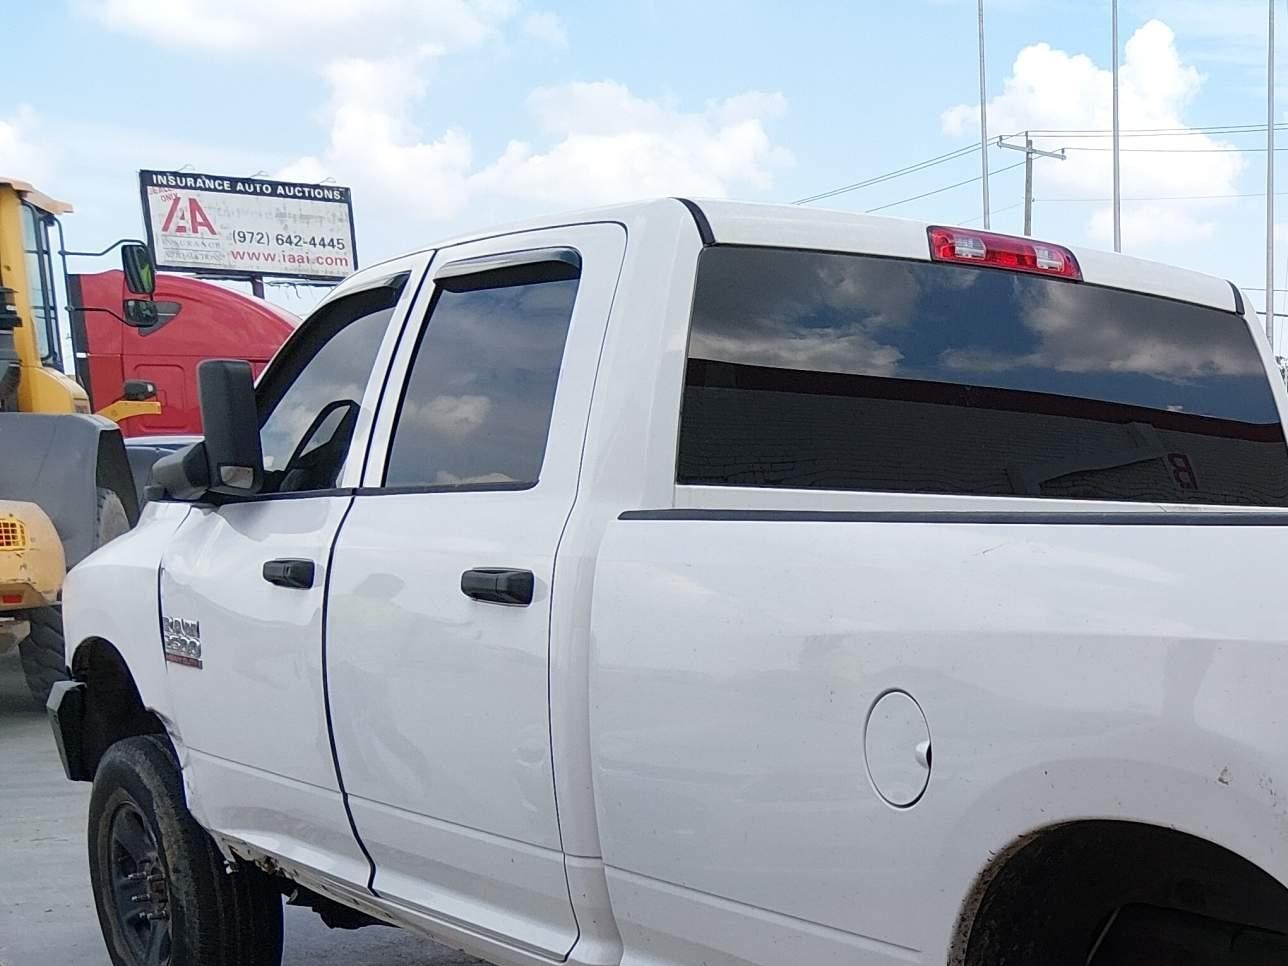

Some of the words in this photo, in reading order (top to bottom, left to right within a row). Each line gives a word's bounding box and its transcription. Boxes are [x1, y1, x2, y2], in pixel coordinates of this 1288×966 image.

[153, 174, 231, 190] INSURANCE
[236, 182, 272, 194] AUTO
[232, 229, 270, 246] (972)
[275, 233, 345, 250] 642-4445
[231, 250, 349, 267] www.iaai.com
